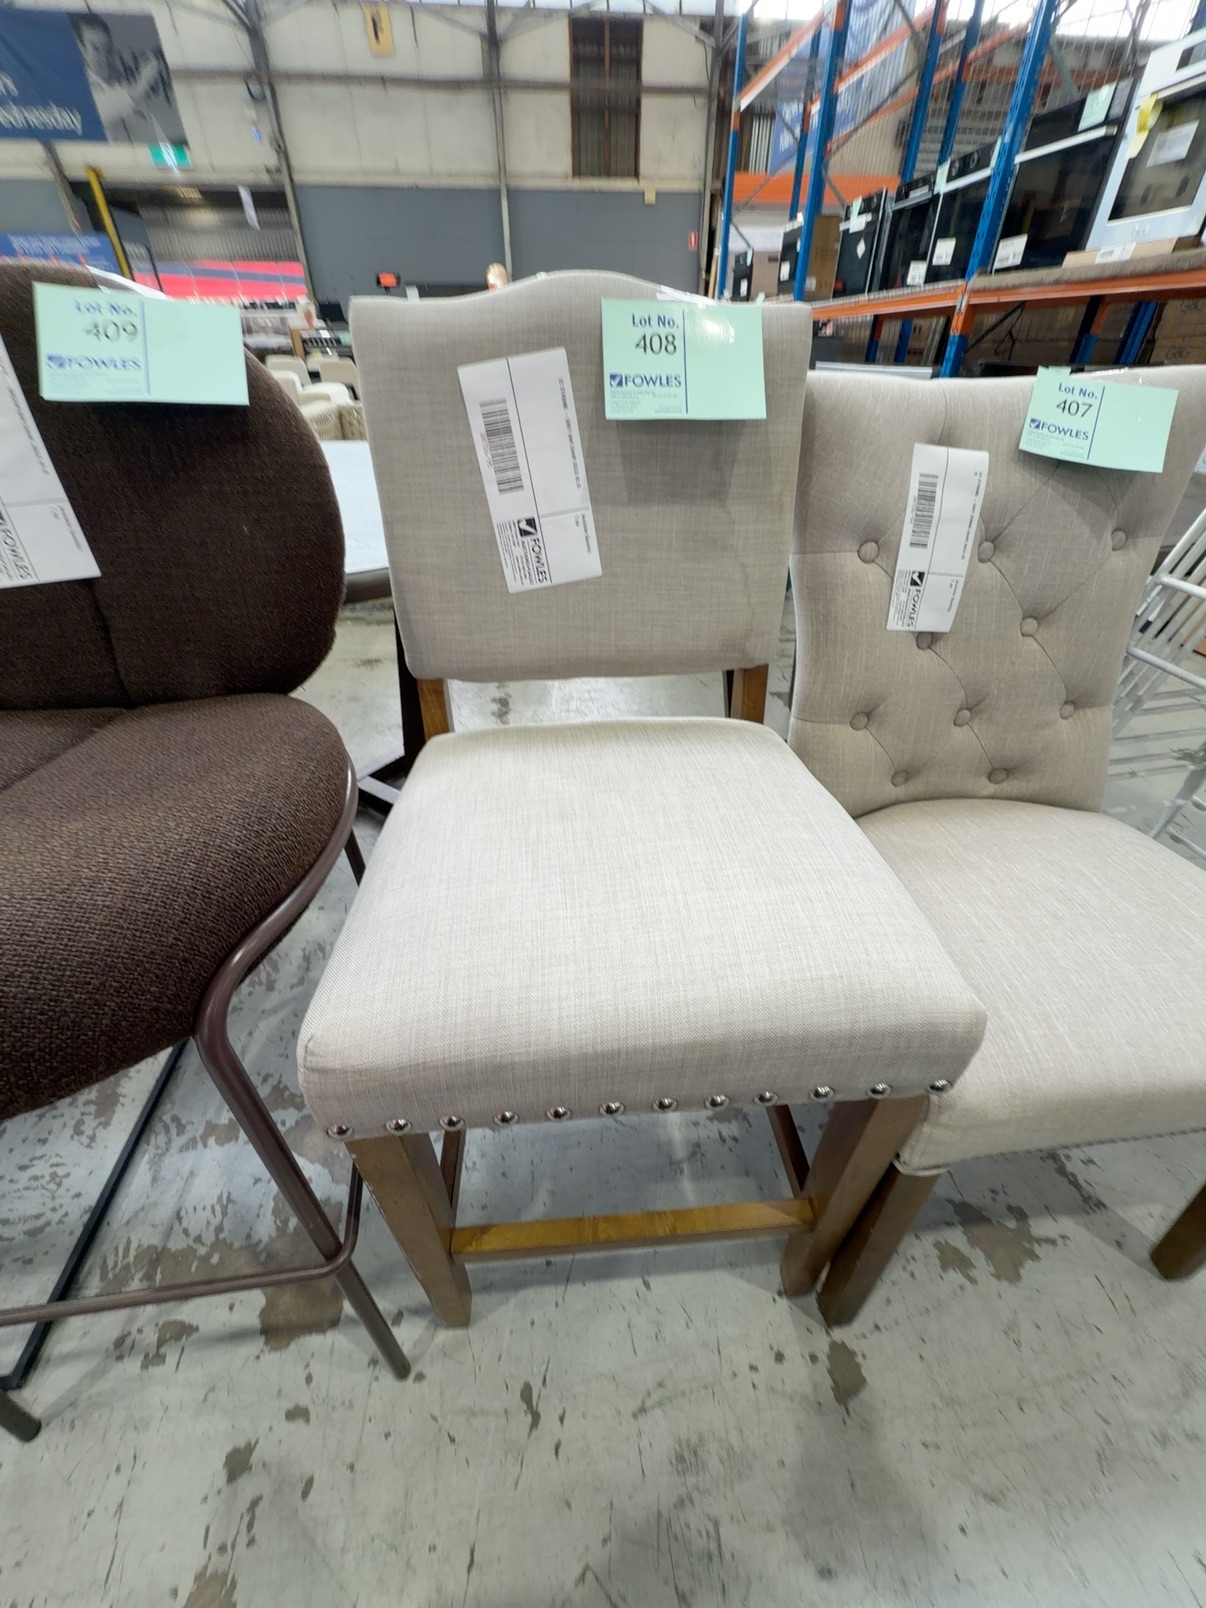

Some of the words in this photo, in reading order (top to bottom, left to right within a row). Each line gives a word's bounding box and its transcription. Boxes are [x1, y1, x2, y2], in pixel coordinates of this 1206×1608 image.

[0, 100, 82, 136] ednesday
[75, 300, 102, 315] Lot
[109, 302, 138, 317] No.
[83, 319, 138, 343] 409
[632, 313, 652, 328] Lot
[657, 314, 680, 329] No.
[635, 331, 677, 355] 408
[68, 355, 142, 371] FOWLES
[624, 373, 682, 388] FOWLES
[1058, 382, 1075, 396] Lot
[1078, 387, 1098, 400] No.
[1056, 399, 1093, 418] 407
[1040, 421, 1089, 441] FOWLES
[0, 524, 34, 580] FOWLES
[530, 538, 548, 585] FOWLES
[907, 588, 922, 628] FOWLES
